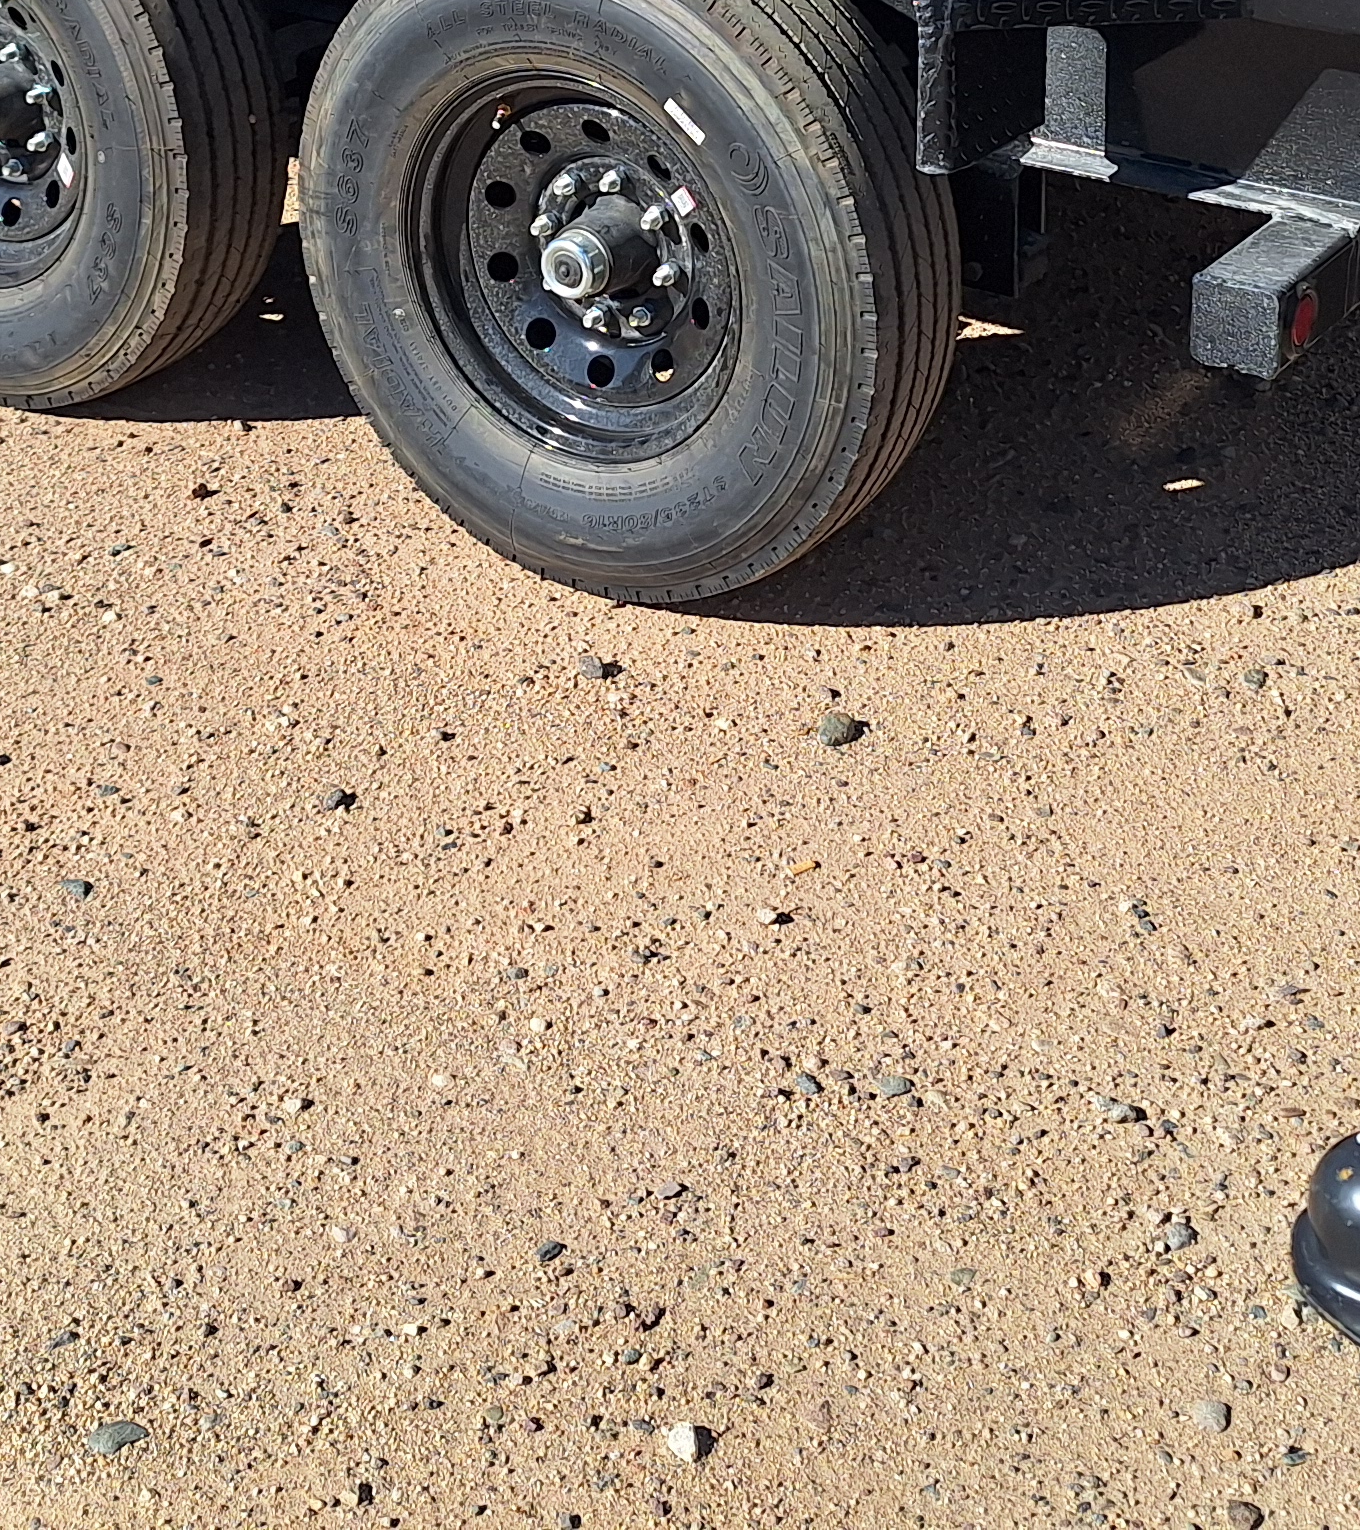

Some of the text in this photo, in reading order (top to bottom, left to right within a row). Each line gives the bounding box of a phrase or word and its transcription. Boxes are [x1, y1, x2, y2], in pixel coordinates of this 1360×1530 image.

[572, 8, 670, 75] RADIAL
[334, 116, 371, 238] S637
[86, 201, 124, 307] S637
[735, 205, 804, 488] SAILUN
